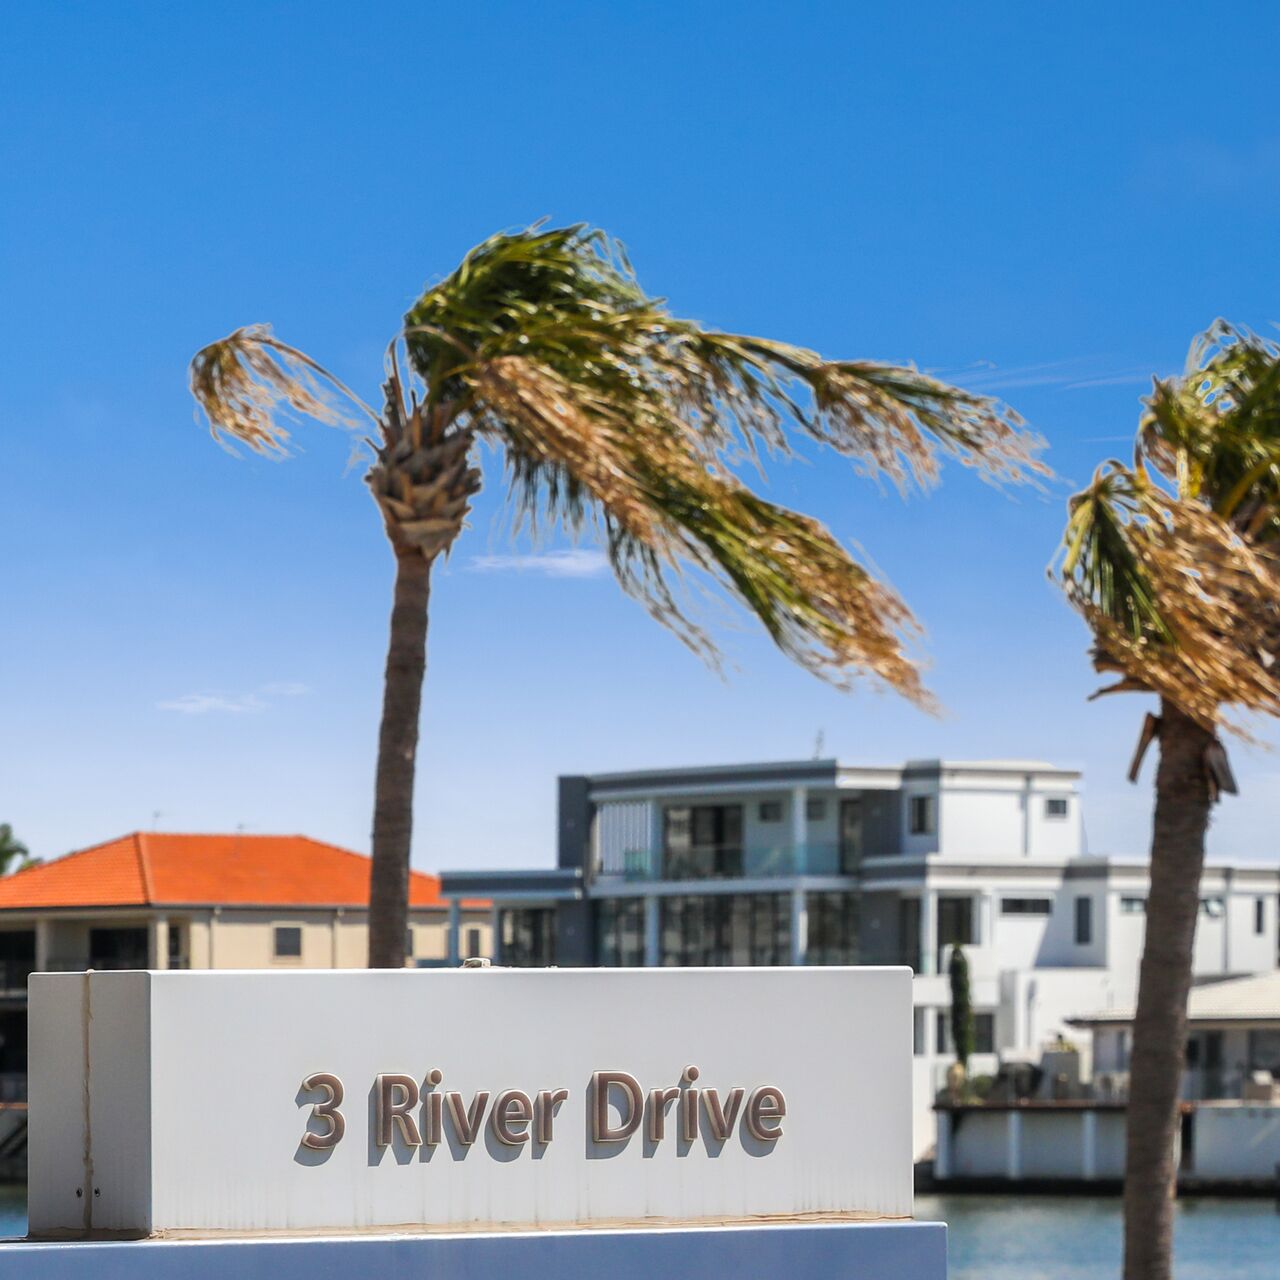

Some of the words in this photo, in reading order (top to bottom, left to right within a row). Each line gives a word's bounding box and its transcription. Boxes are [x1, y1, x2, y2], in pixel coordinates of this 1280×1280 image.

[301, 1071, 346, 1150] 3
[375, 1067, 571, 1147] River
[590, 1063, 788, 1144] Drive
